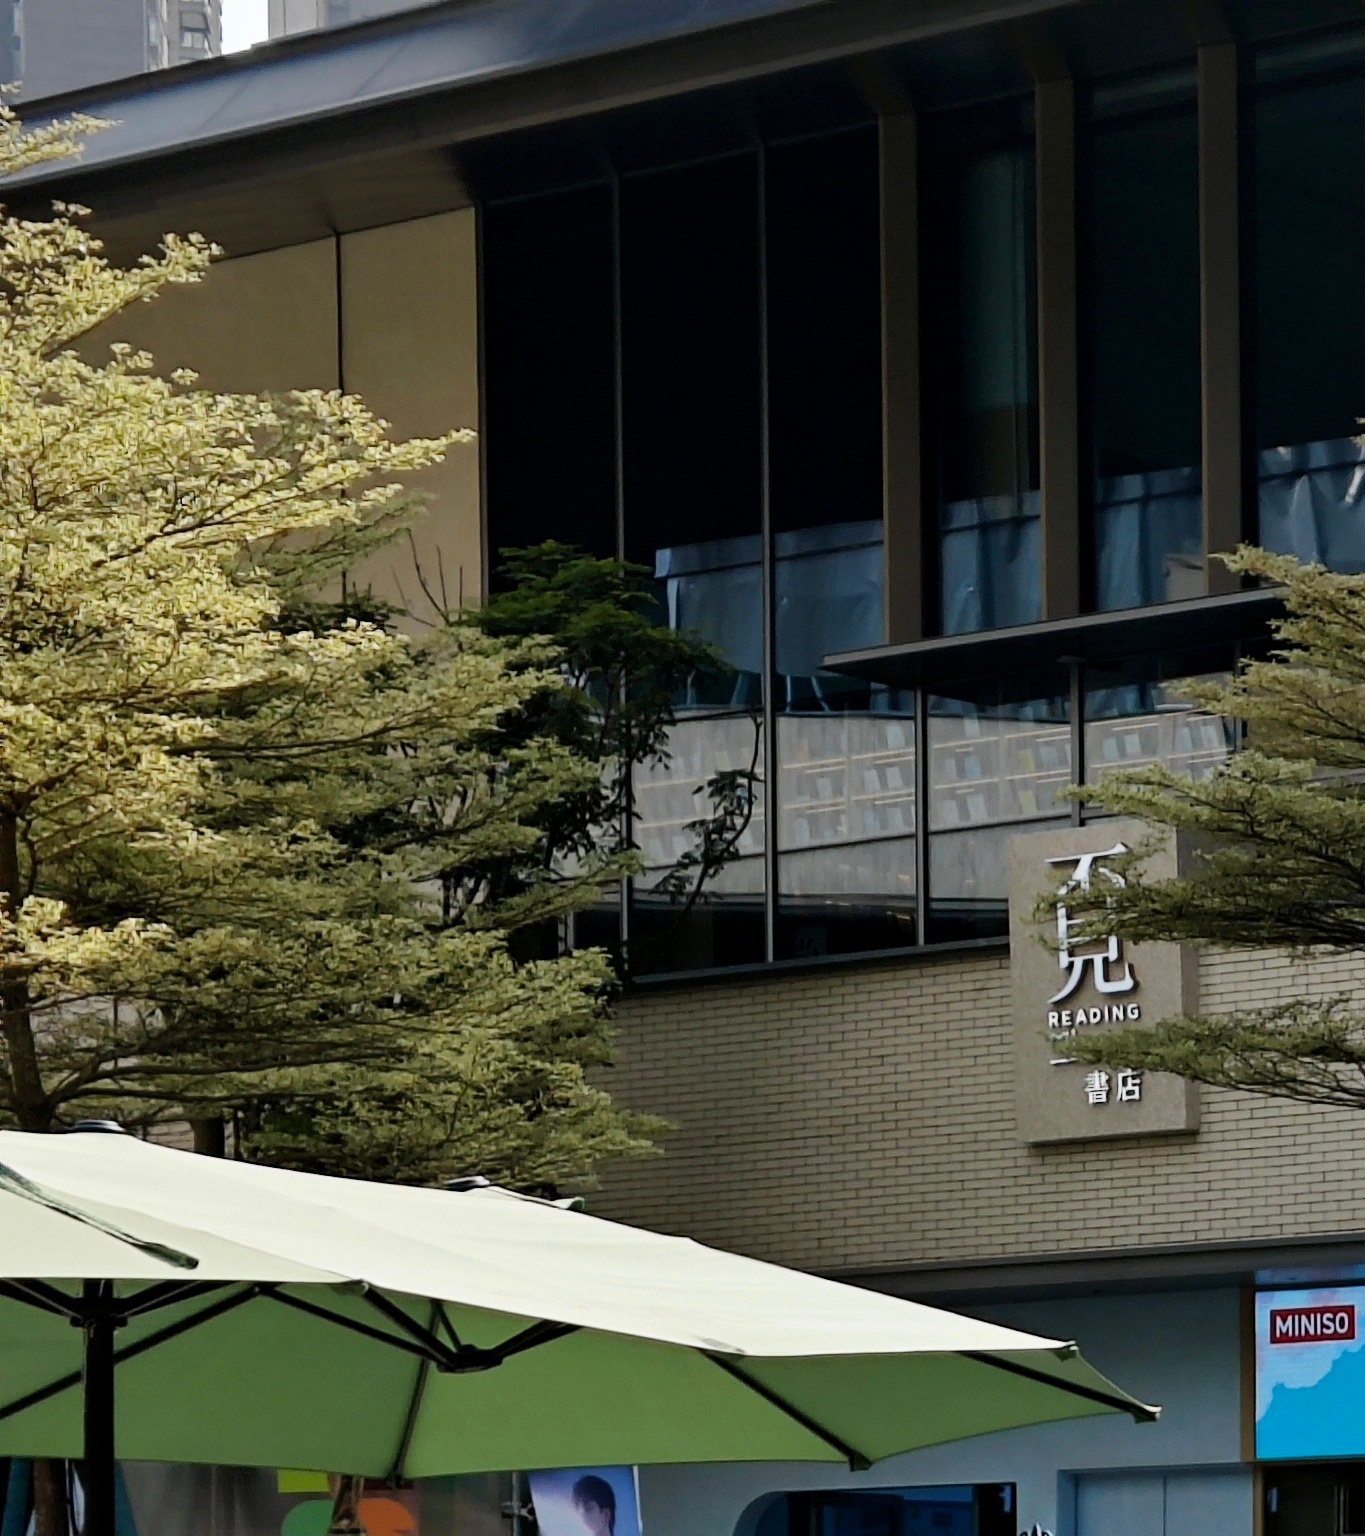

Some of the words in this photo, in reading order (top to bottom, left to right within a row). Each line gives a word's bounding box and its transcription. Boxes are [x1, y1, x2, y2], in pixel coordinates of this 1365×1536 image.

[1048, 1003, 1140, 1027] READING
[1084, 1067, 1143, 1105] 書店
[1275, 1312, 1349, 1338] MINISO
